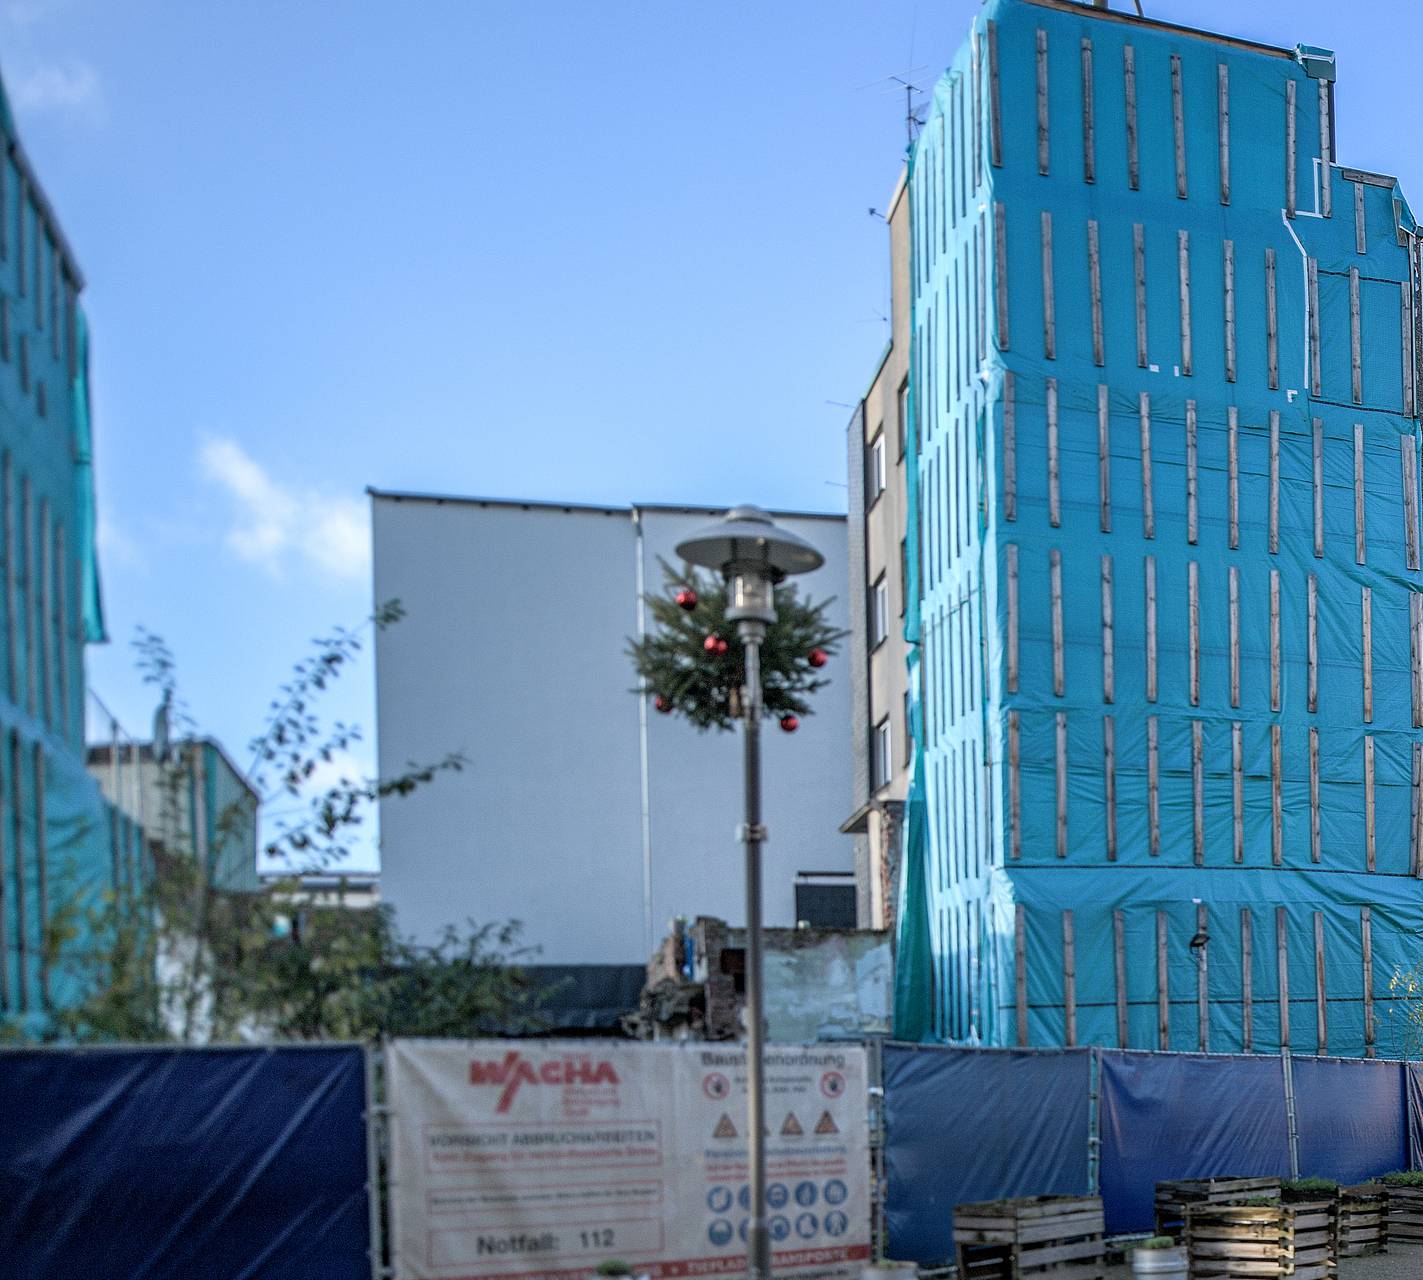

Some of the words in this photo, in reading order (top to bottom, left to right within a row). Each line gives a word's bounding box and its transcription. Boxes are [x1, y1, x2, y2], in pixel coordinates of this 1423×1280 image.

[469, 1051, 620, 1114] WACHA
[477, 1231, 560, 1254] Notfall:
[580, 1228, 615, 1248] 112
